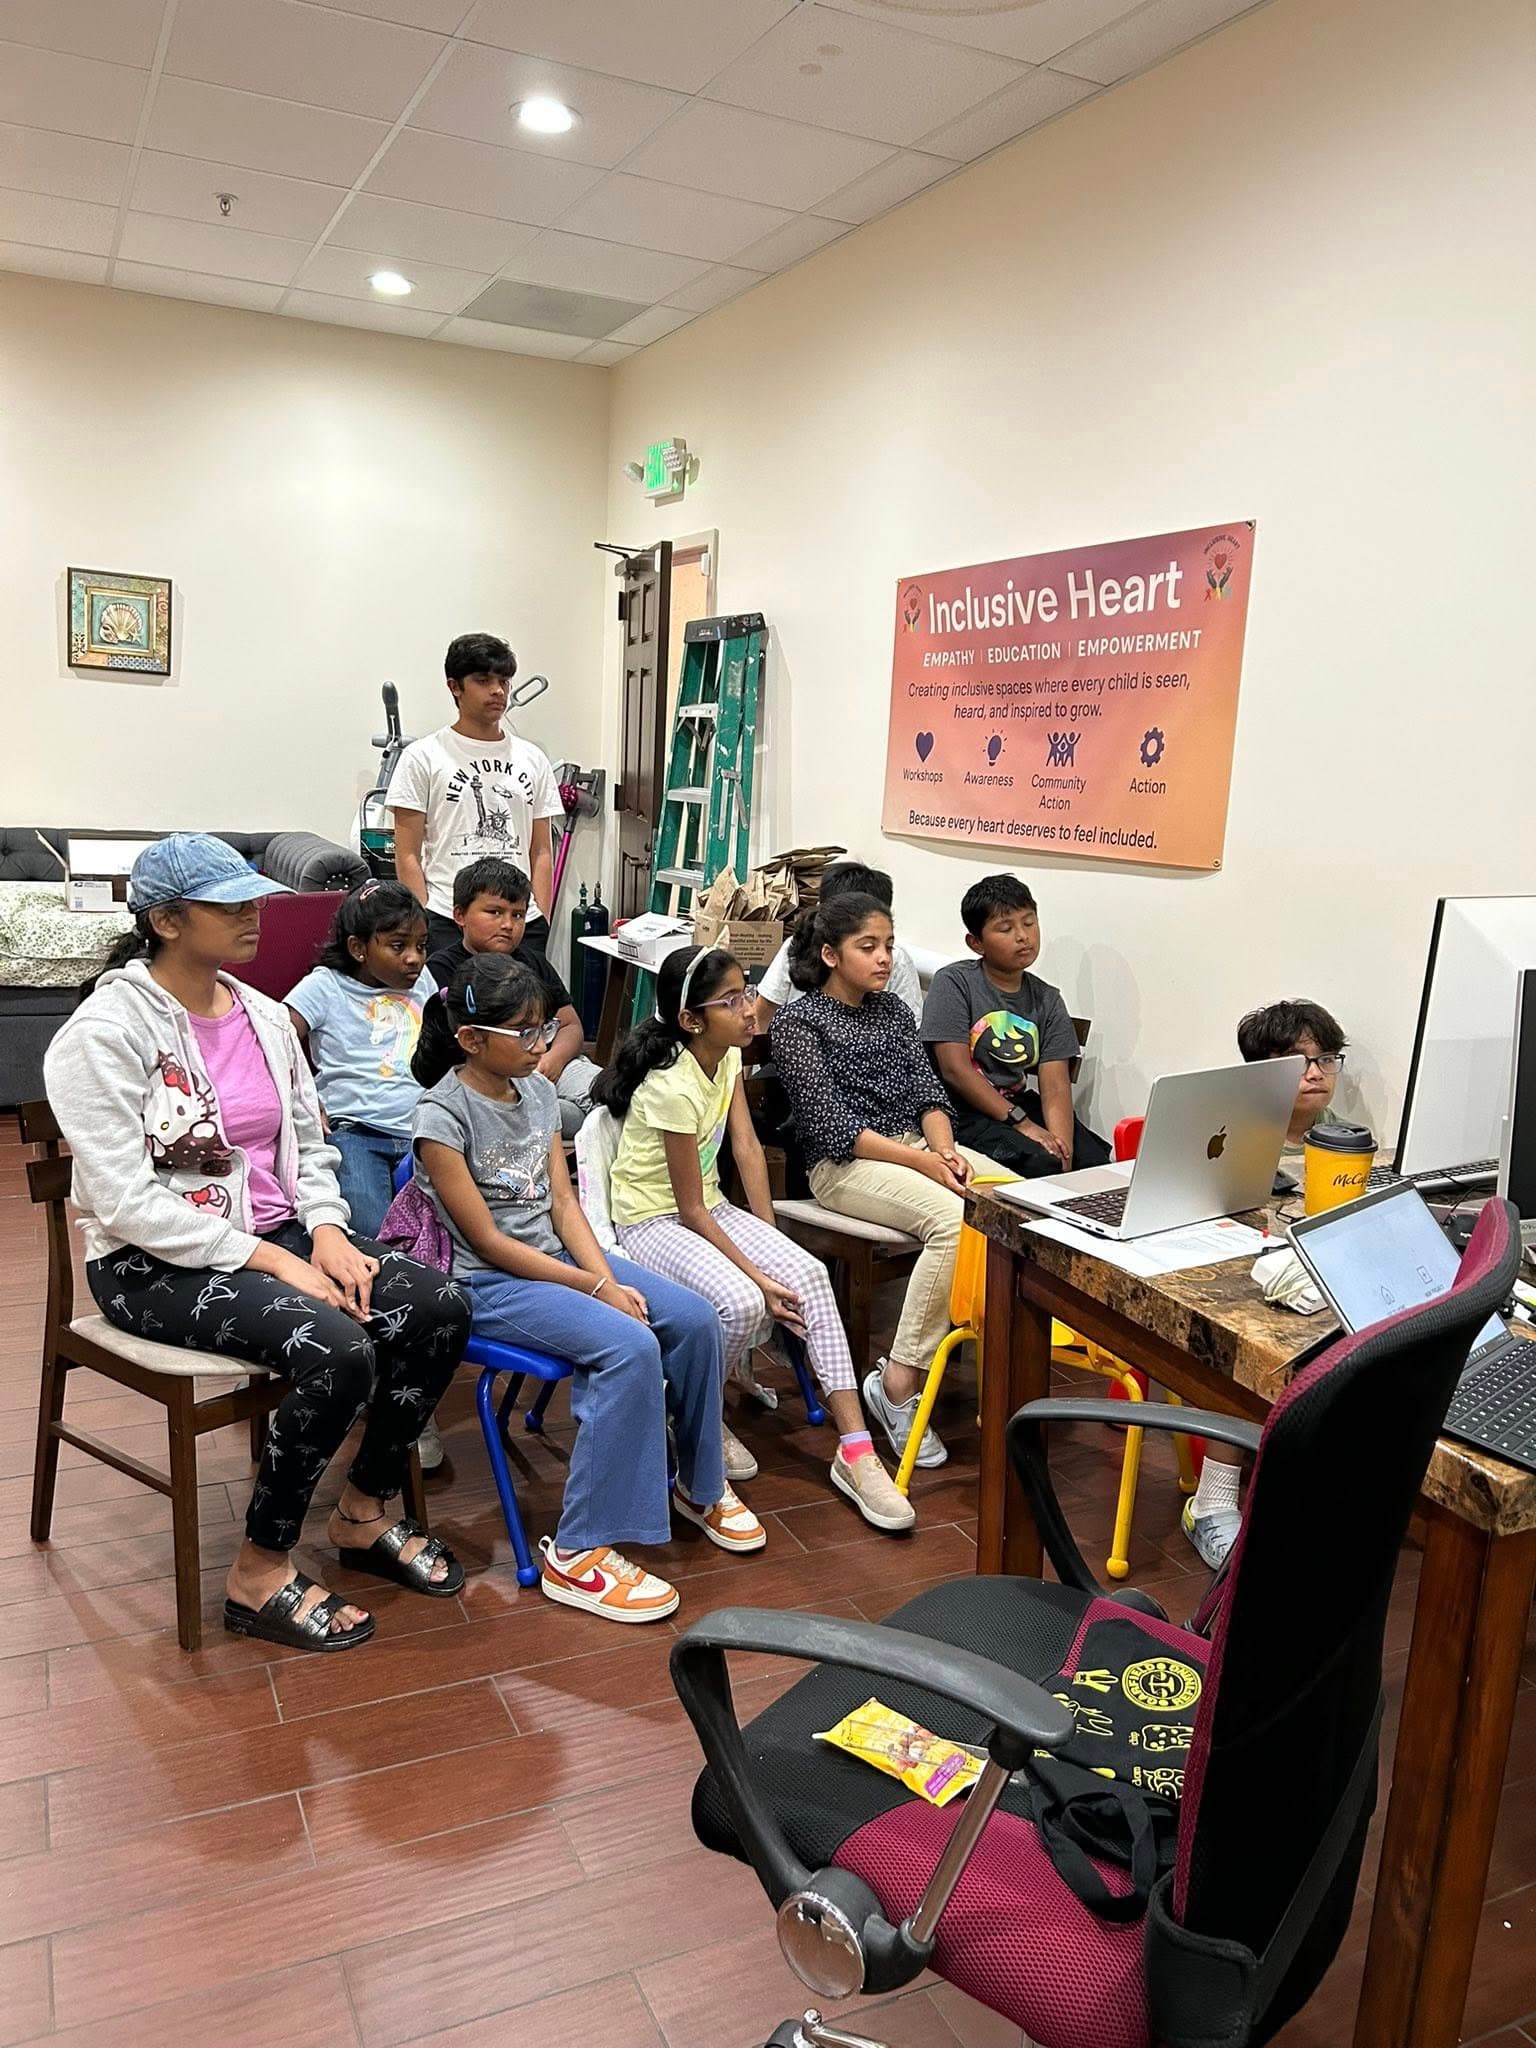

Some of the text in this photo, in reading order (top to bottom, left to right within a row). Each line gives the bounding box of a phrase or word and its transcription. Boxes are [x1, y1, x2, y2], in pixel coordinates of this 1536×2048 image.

[928, 561, 1183, 634] Inclusive Heart
[923, 629, 1202, 668] EMPATHY EDUCATION EMPOWERMENT
[908, 672, 1190, 701] Creating inclusive spaces where every child is seen,
[954, 702, 1102, 722] heard, and inspired to grow.
[446, 759, 534, 807] NEW YORK CITY
[903, 768, 944, 785] Workshops
[963, 771, 1014, 787] Awareness
[1031, 774, 1087, 794] Community
[1129, 777, 1167, 794] Action
[1038, 795, 1071, 810] Action
[909, 809, 1157, 849] Because every heart deserves to feel included.
